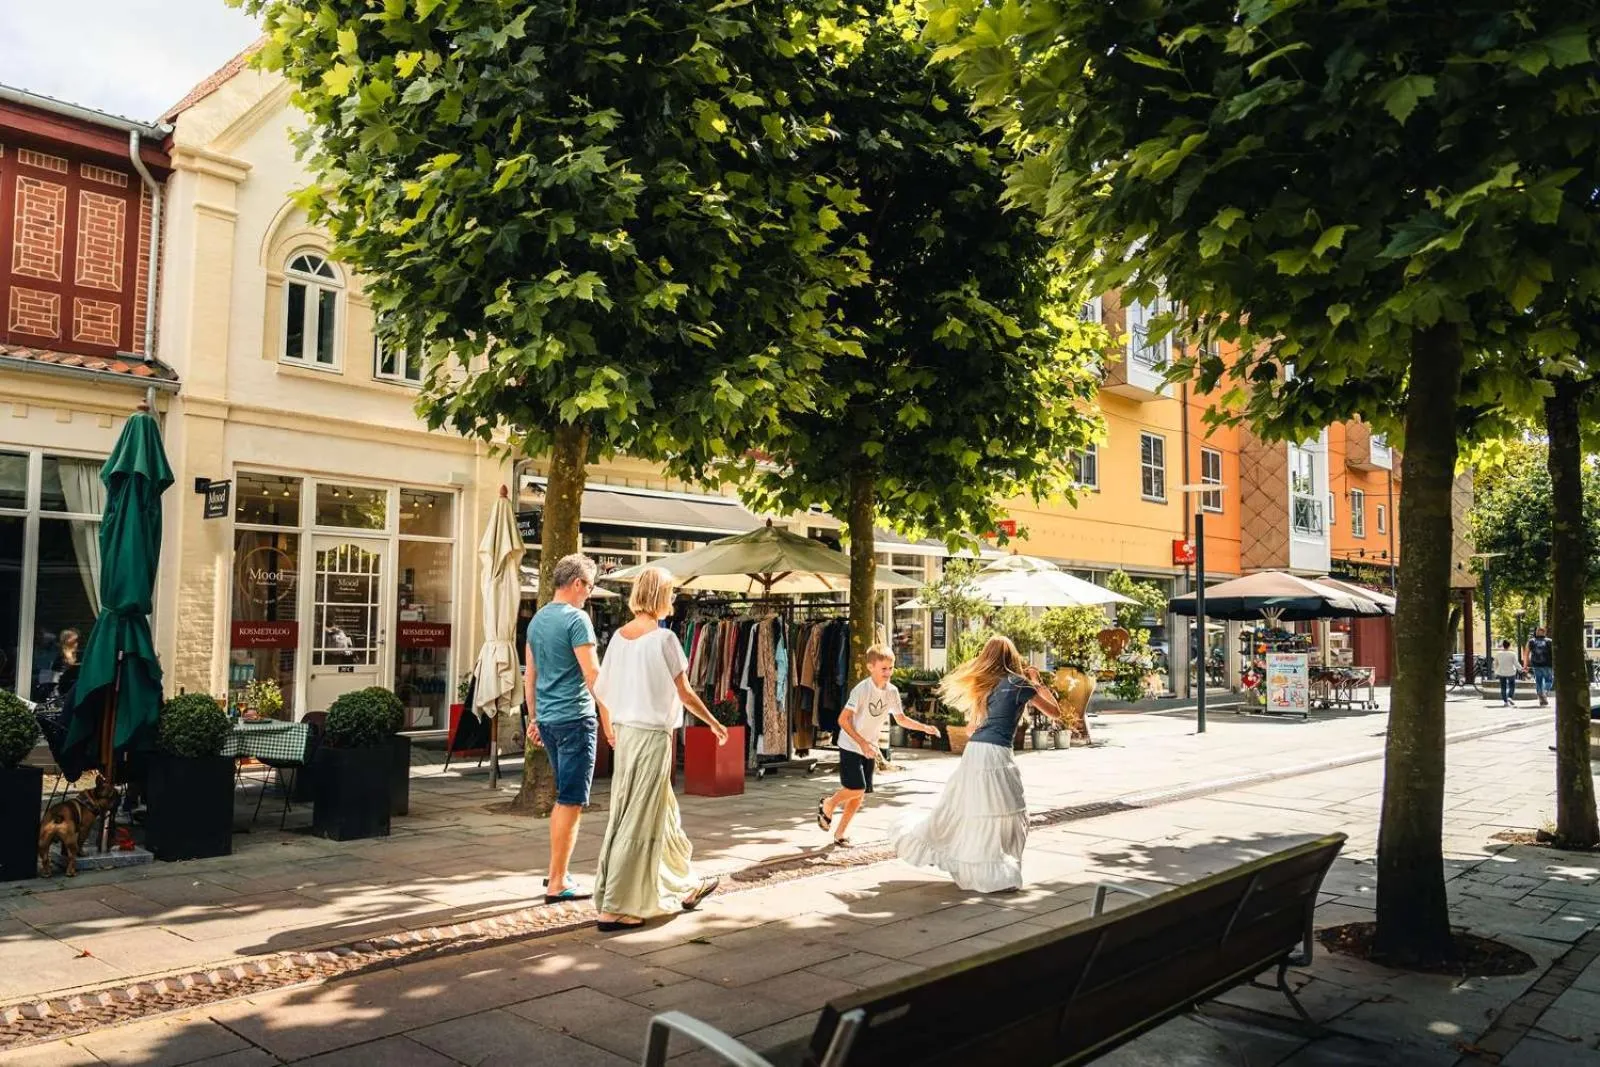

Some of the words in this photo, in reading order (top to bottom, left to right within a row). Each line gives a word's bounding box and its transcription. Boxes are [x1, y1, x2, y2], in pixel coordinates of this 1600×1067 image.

[209, 489, 226, 504] Mood
[599, 555, 623, 568] BUTIK
[249, 568, 283, 581] Mood
[337, 578, 359, 587] Mood
[239, 627, 290, 636] KOSMETOLOG
[402, 628, 445, 636] KOSMETOLOG
